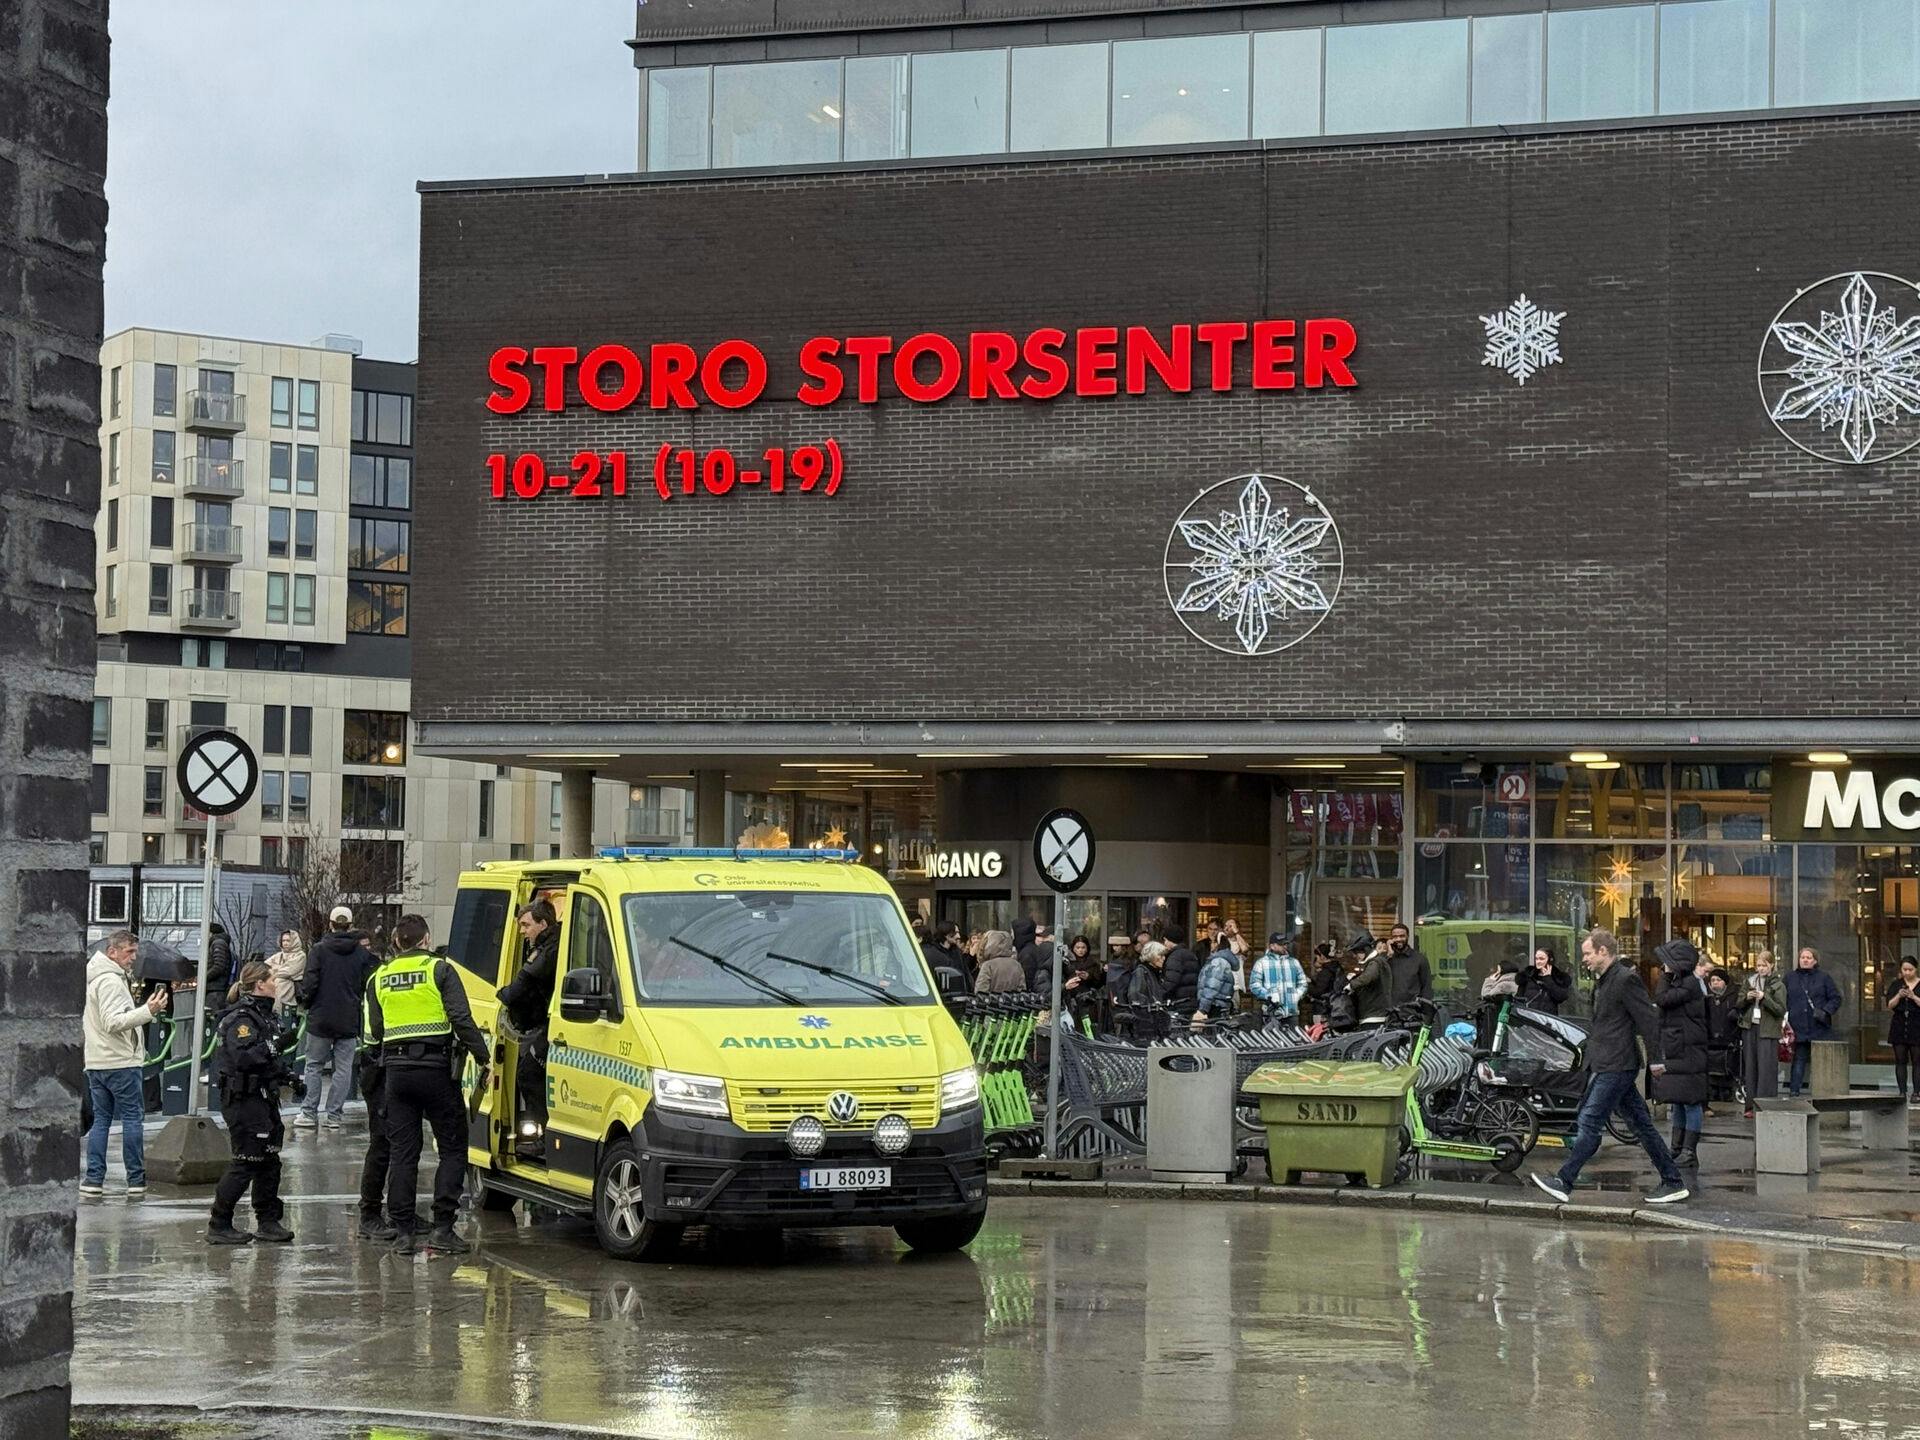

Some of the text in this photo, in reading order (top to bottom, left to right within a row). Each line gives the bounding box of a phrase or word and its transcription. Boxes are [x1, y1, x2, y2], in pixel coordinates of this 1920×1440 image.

[486, 317, 1358, 415] STORO STORSENTER
[486, 440, 845, 498] 10-21 (10-19)
[1803, 771, 1920, 829] Mc
[381, 972, 426, 988] POLITI
[719, 1034, 928, 1050] AMBULANSE
[1297, 1102, 1358, 1122] SAND
[815, 1169, 886, 1187] LJ 88093
